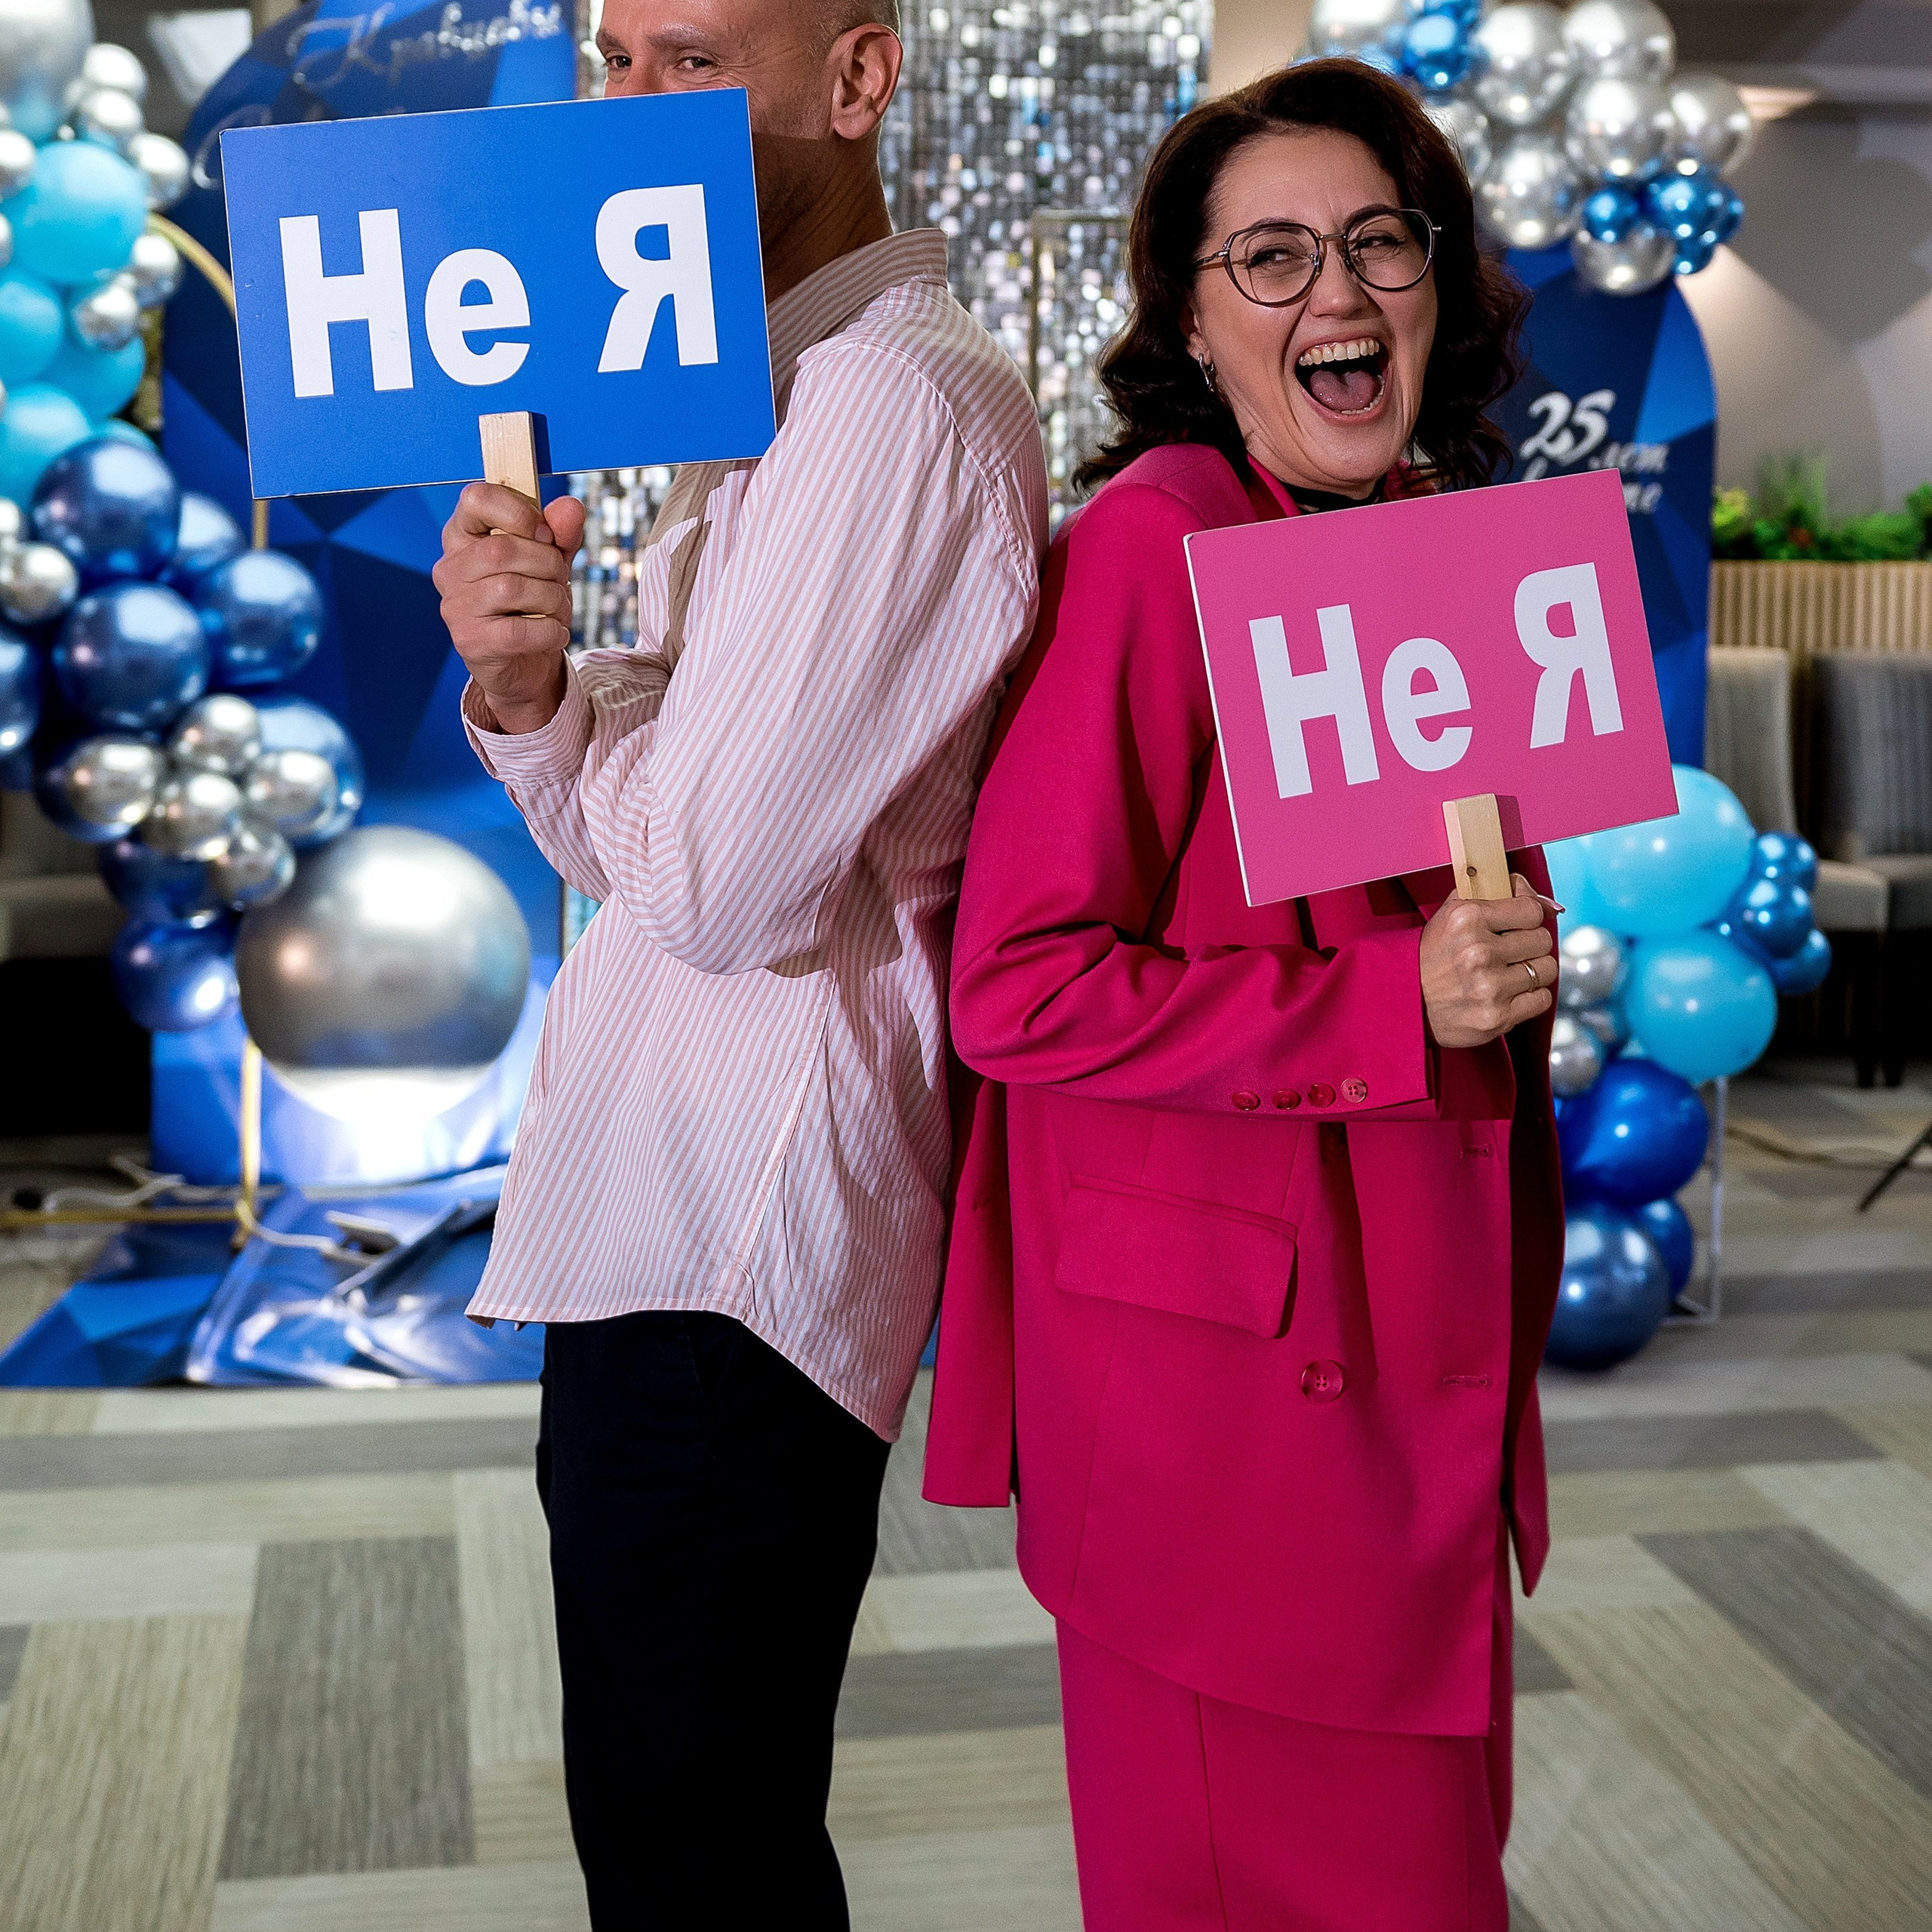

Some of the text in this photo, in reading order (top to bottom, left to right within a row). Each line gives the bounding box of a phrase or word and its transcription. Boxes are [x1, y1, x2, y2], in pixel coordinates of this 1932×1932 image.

[279, 183, 719, 398] Не Я
[1519, 388, 1617, 467] 25
[1248, 561, 1625, 799] Не Я
